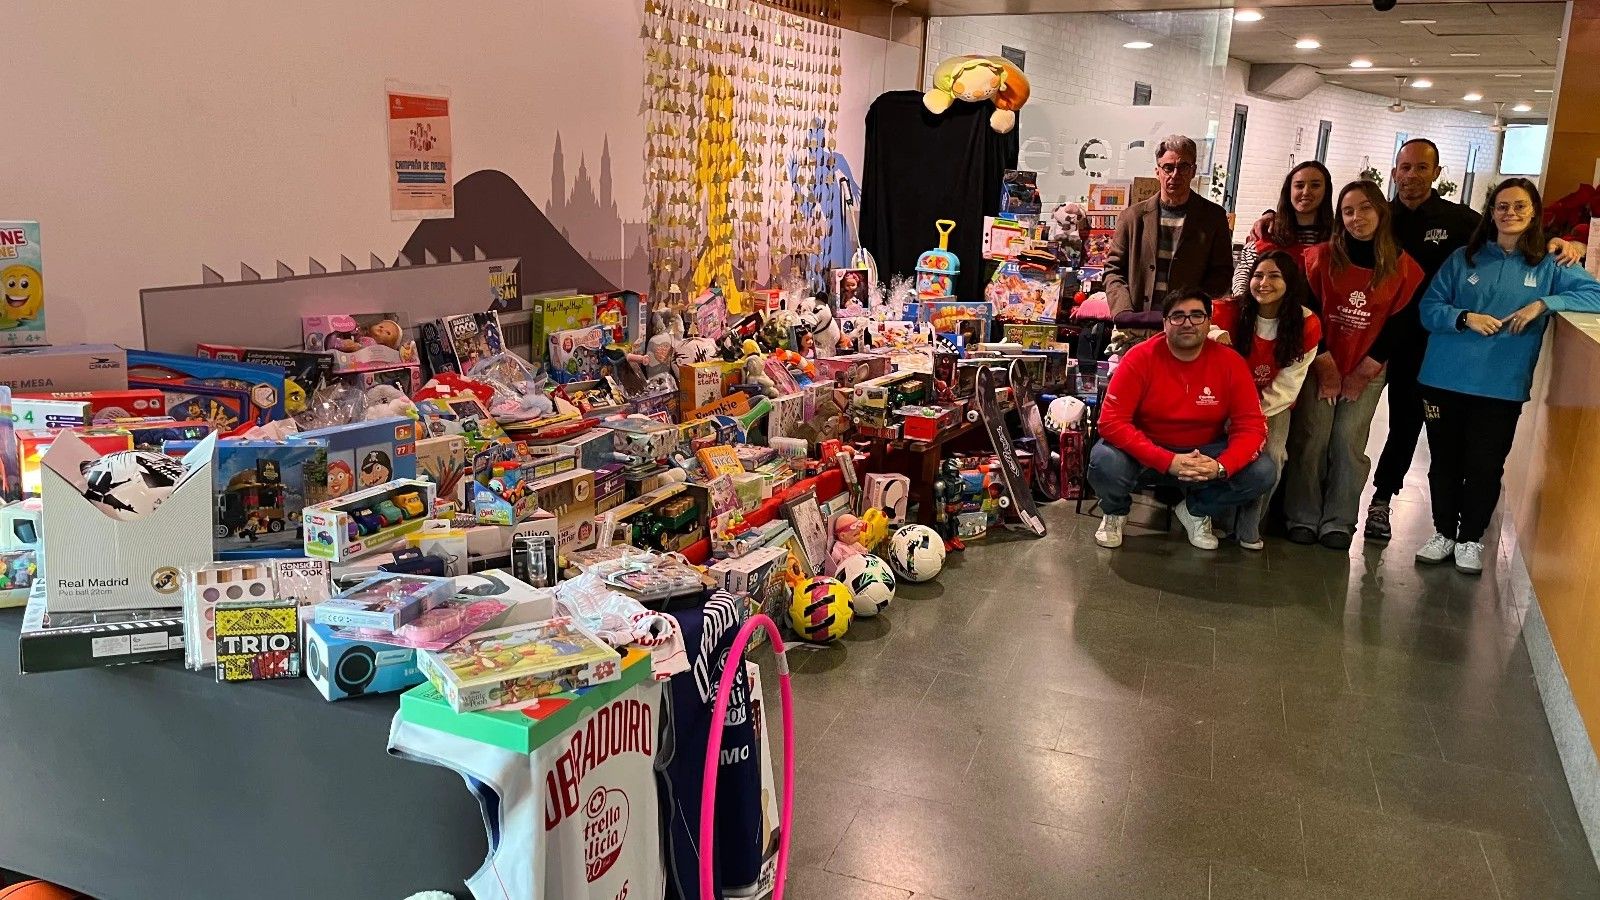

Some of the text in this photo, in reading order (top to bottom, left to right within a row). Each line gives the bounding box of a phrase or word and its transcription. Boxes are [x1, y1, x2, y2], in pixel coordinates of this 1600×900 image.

[395, 158, 422, 170] CAMPAÑA
[423, 161, 430, 170] DE
[1425, 228, 1448, 241] PUMA
[489, 271, 517, 286] MULTI
[498, 285, 517, 300] SAN
[454, 322, 477, 336] COCO
[89, 362, 121, 370] CRANE
[697, 371, 719, 379] bright
[20, 378, 54, 388] MESA
[697, 378, 720, 386] starts
[396, 445, 407, 454] 77
[348, 543, 362, 554] baby
[58, 577, 129, 588] Real Madrid
[748, 572, 759, 586] 50
[75, 588, 90, 596] ball
[90, 588, 113, 596] 22cm
[223, 634, 290, 654] TRIO
[545, 699, 653, 832] OBRADOIRO
[584, 804, 621, 841] trella
